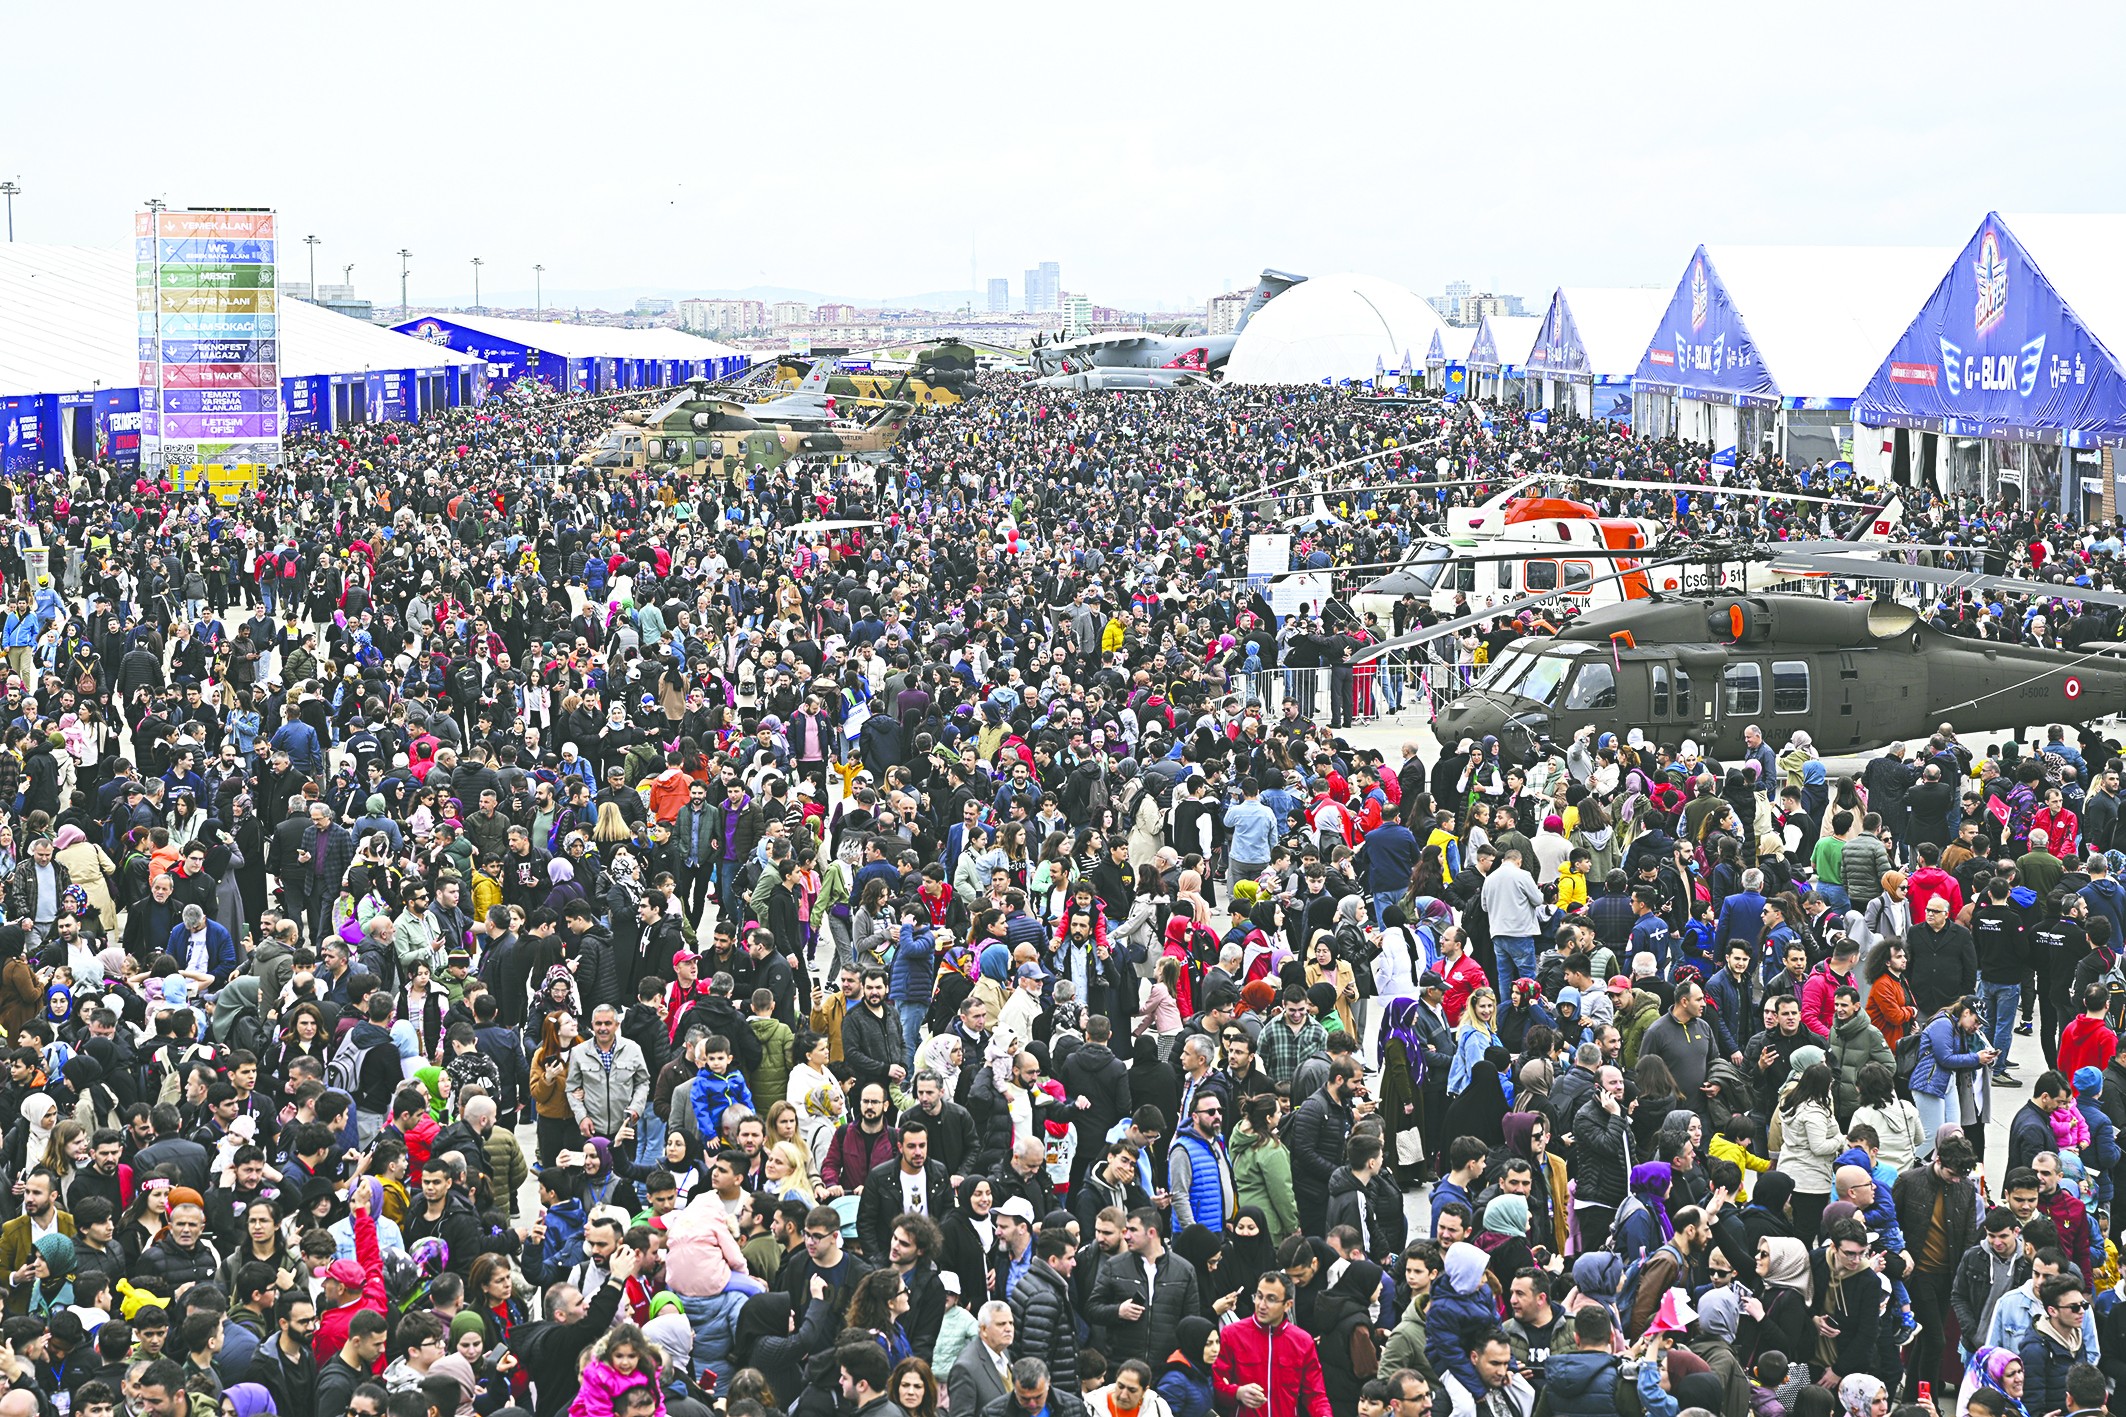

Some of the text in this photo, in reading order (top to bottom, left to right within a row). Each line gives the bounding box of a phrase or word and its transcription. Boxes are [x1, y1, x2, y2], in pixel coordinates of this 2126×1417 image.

[181, 222, 252, 230] YEMEK ALANI
[207, 244, 228, 252] WC
[220, 297, 250, 305] ALANI
[200, 351, 241, 359] MAĞAZA
[1686, 344, 1712, 370] F-BLOK
[1964, 355, 2018, 391] G-BLOK
[1679, 573, 1707, 587] CSG
[2019, 686, 2049, 699] J-5002
